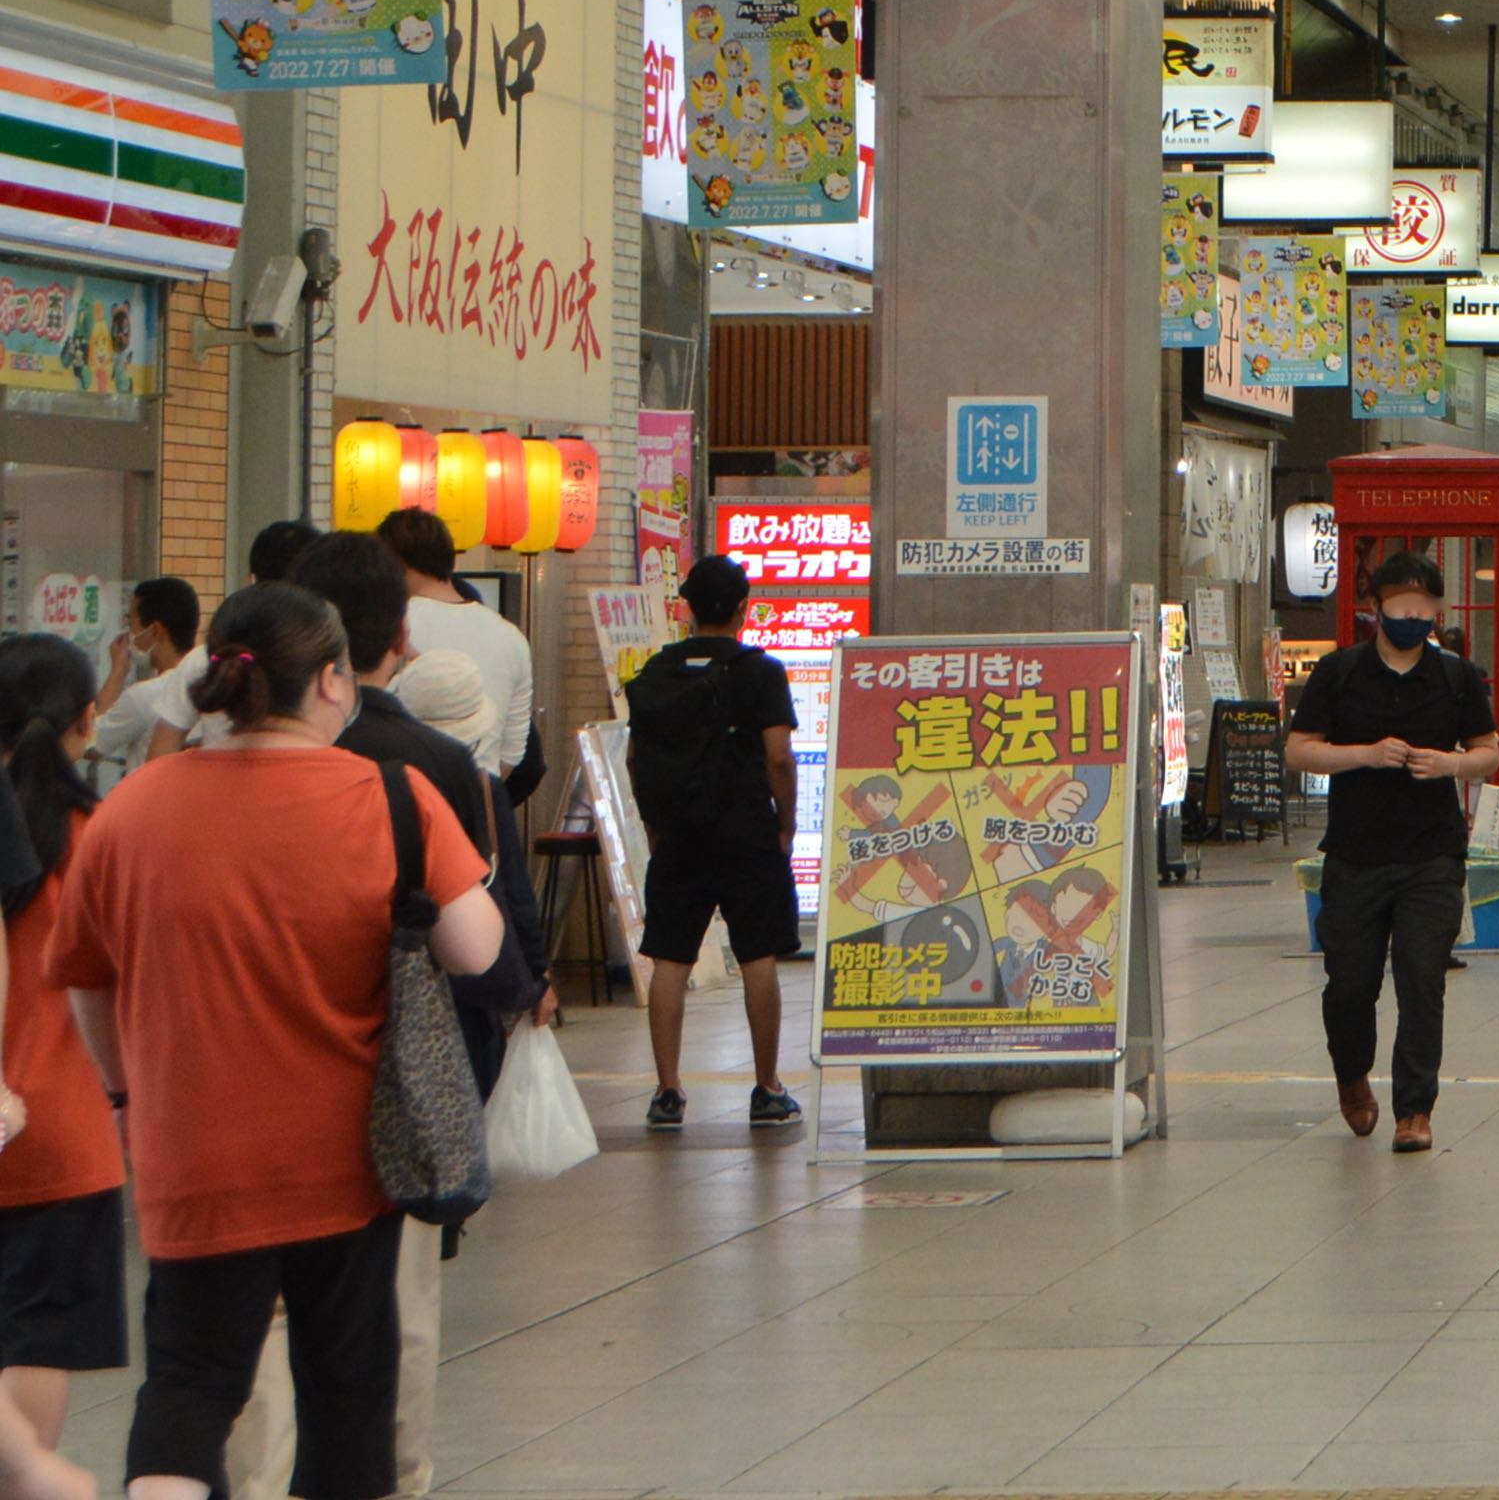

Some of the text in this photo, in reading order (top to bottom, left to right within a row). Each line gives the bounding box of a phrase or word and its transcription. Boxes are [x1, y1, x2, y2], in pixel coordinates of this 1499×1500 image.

[268, 58, 350, 80] 2022.7.27
[727, 203, 789, 220] 2022.7.27
[1353, 248, 1371, 267] 保
[358, 189, 601, 374] 大阪伝統の味
[956, 492, 1038, 513] 左側通行
[1356, 490, 1493, 507] TELEPHONE
[728, 513, 872, 546] 飲み放題込
[964, 514, 1029, 526] KEEP LEFT
[902, 540, 1084, 565] 防犯カメラ設置の街
[1311, 512, 1337, 590] 焼餃子
[850, 652, 1043, 689] その客引きは
[893, 685, 1121, 777] 違法!!
[847, 819, 957, 863] 後をつける
[983, 817, 1098, 846] 腕をつかむ
[828, 942, 949, 971] 防犯カメラ
[1033, 949, 1113, 979] しつこく
[832, 967, 942, 1007] 撮影中
[1028, 975, 1092, 1001] からむ
